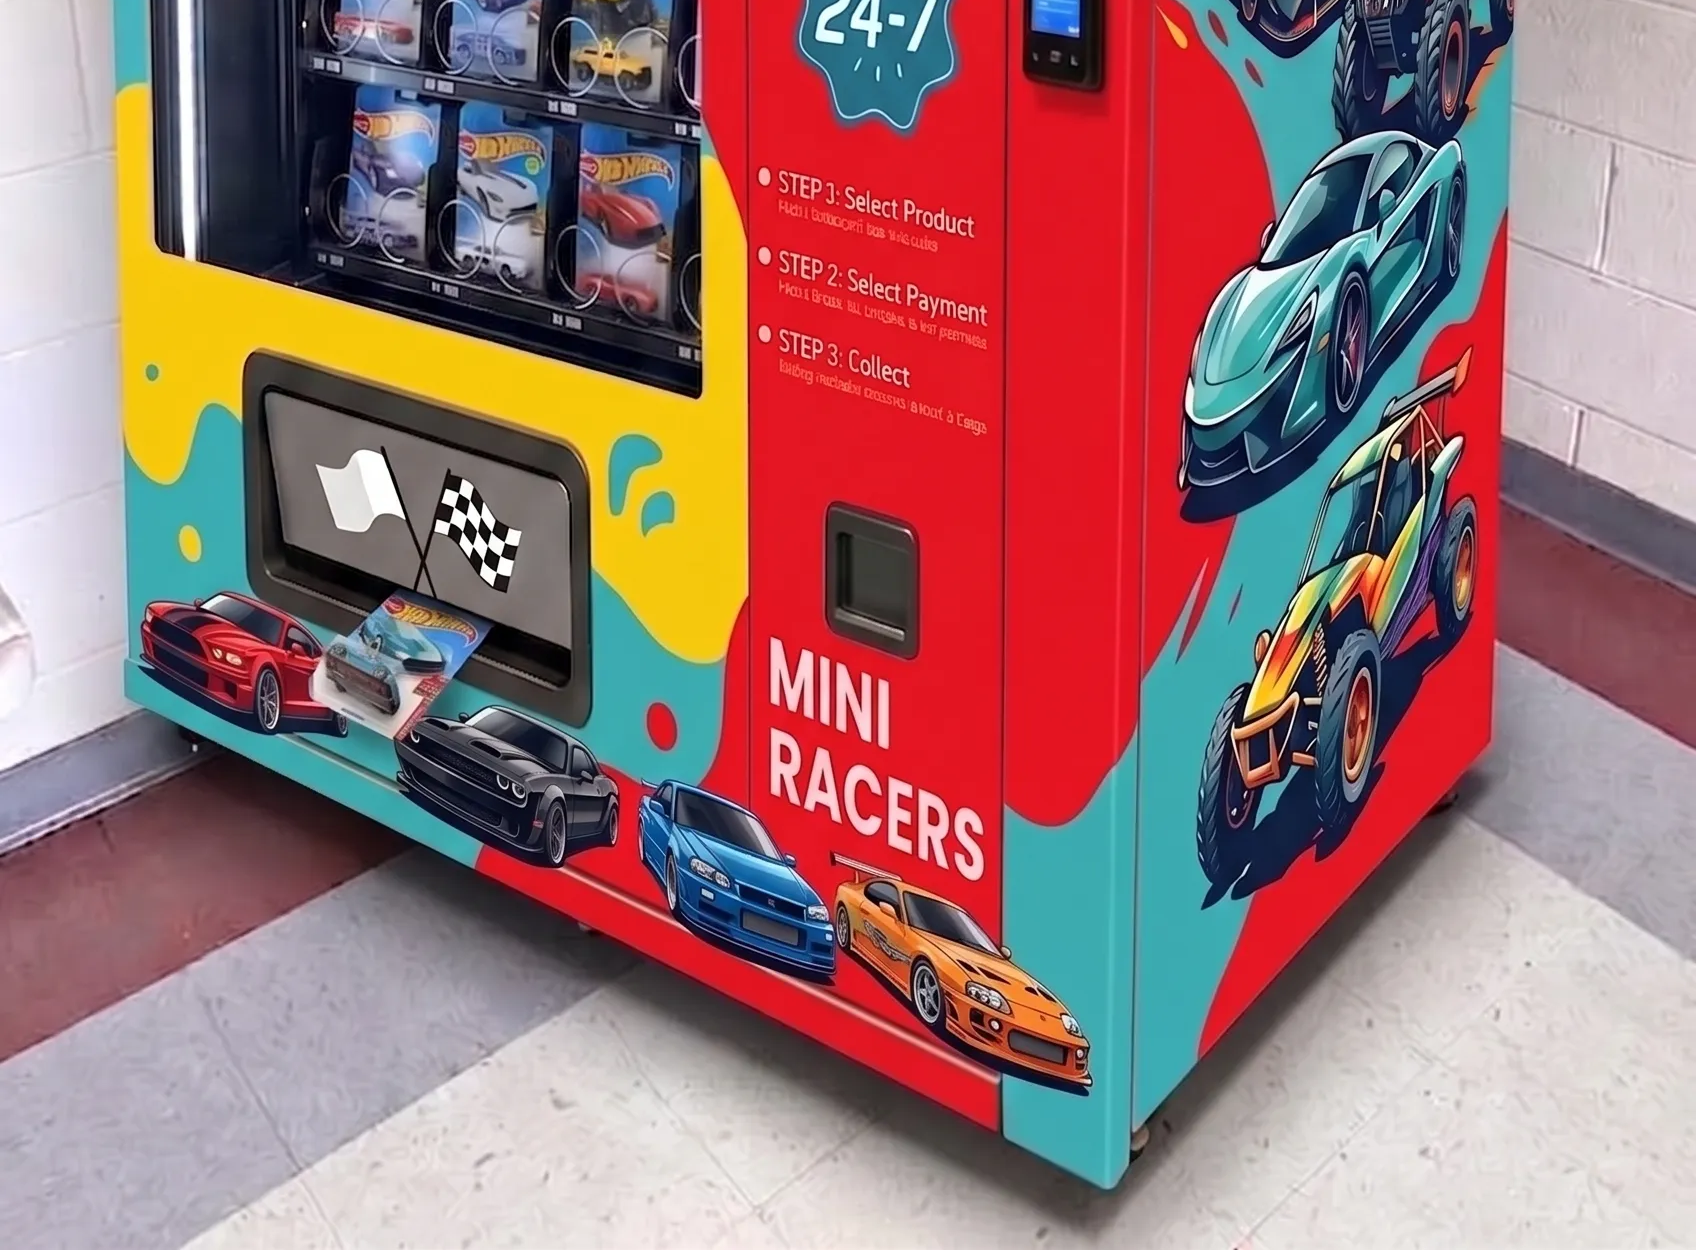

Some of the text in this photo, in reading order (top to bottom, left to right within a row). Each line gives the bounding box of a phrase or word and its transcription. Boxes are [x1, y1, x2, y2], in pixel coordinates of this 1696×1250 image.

[778, 170, 823, 201] STEP
[844, 186, 899, 221] Select
[903, 199, 975, 239] Product
[778, 250, 823, 282] STEP
[827, 264, 843, 288] 2:
[848, 268, 902, 305] Select
[906, 283, 988, 327] Payment
[778, 329, 911, 389] STEP 3: Collect
[769, 636, 890, 750] MINI
[769, 726, 985, 882] RACERS
